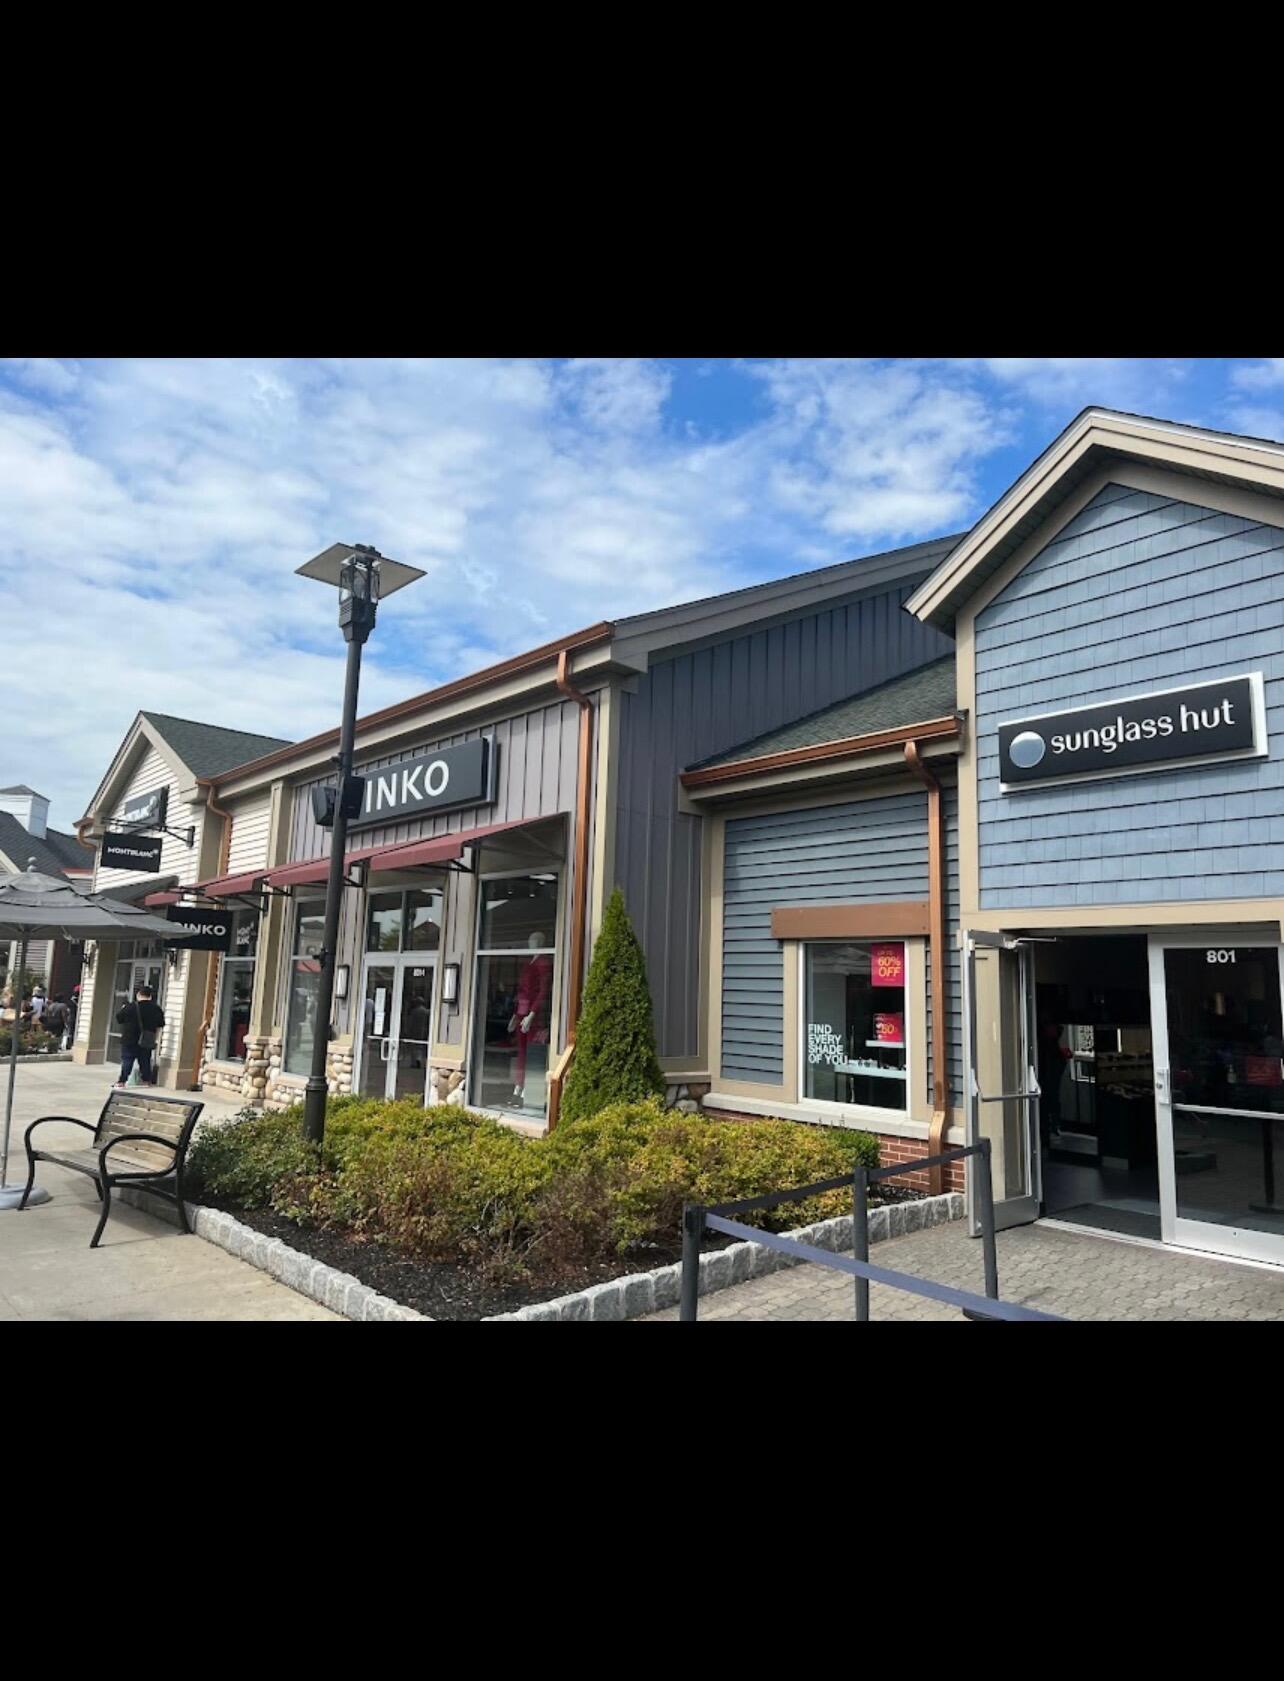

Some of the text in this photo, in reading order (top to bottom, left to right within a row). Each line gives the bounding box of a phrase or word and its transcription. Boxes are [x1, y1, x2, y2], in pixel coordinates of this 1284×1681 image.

[1051, 698, 1236, 754] sunglass hut
[365, 760, 449, 813] INKO
[107, 846, 153, 858] MONTBLANC
[180, 922, 226, 936] INKO
[1206, 949, 1236, 963] 801
[878, 966, 901, 977] OFF
[808, 1023, 832, 1034] FIND
[808, 1034, 842, 1045] EVERY
[808, 1044, 844, 1055] SHADE
[808, 1053, 848, 1065] OF YOU
